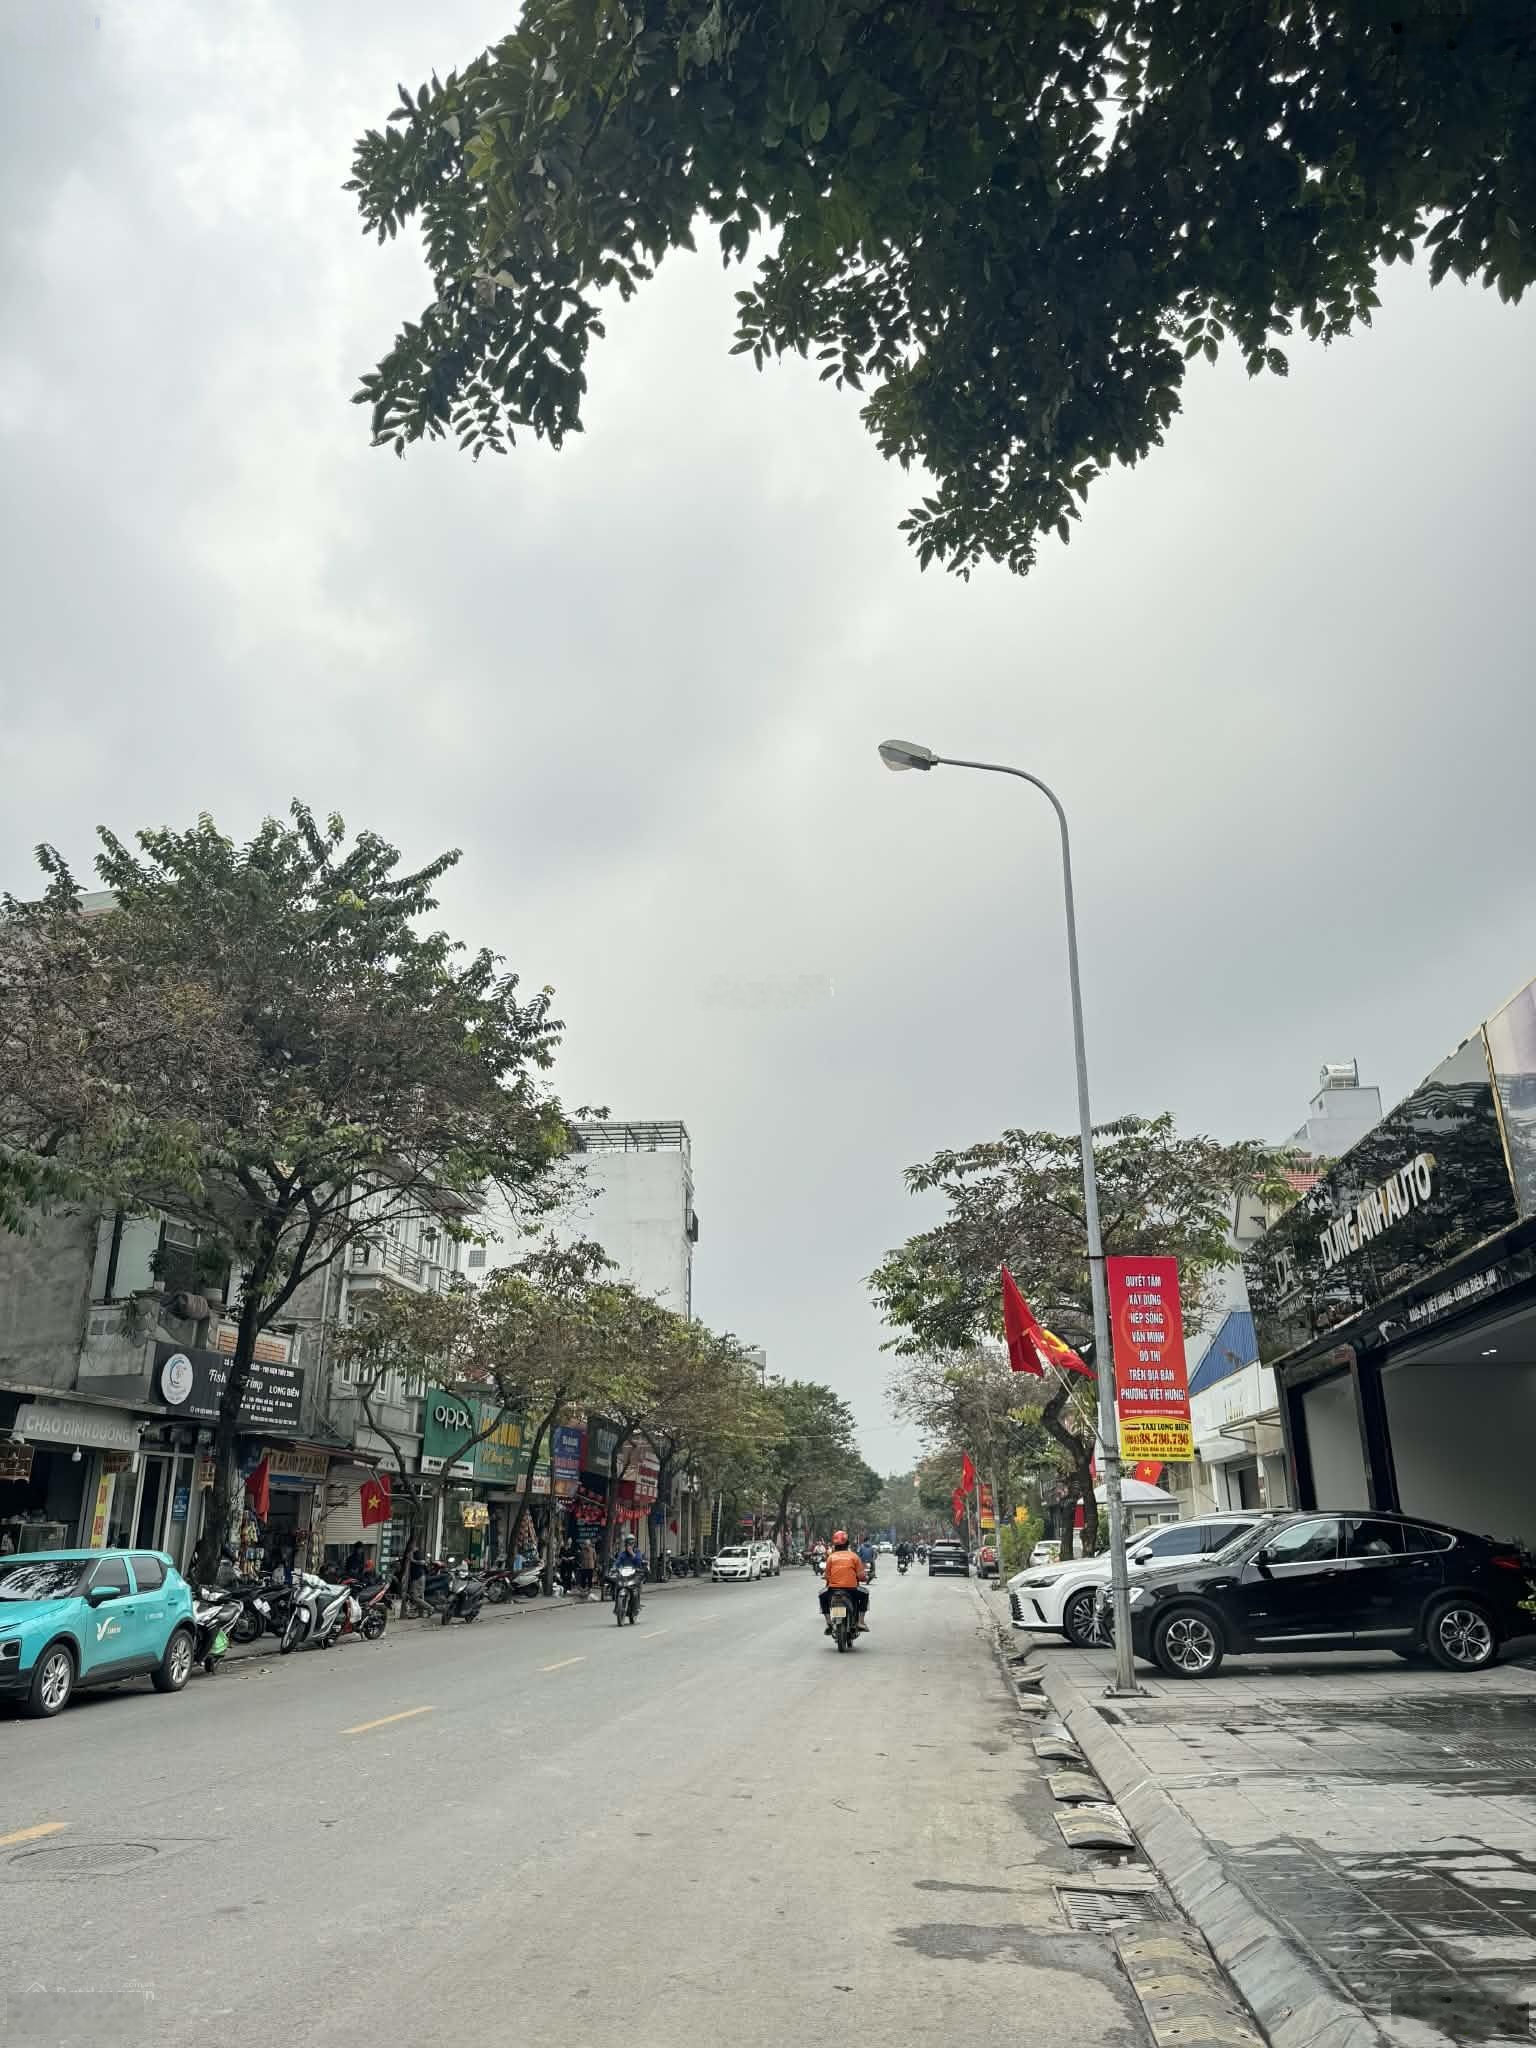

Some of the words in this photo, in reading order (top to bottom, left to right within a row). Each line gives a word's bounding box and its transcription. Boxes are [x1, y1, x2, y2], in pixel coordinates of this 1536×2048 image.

[1147, 1331, 1165, 1343] MINH
[208, 1369, 226, 1383] Fish
[269, 1385, 285, 1396] LONG
